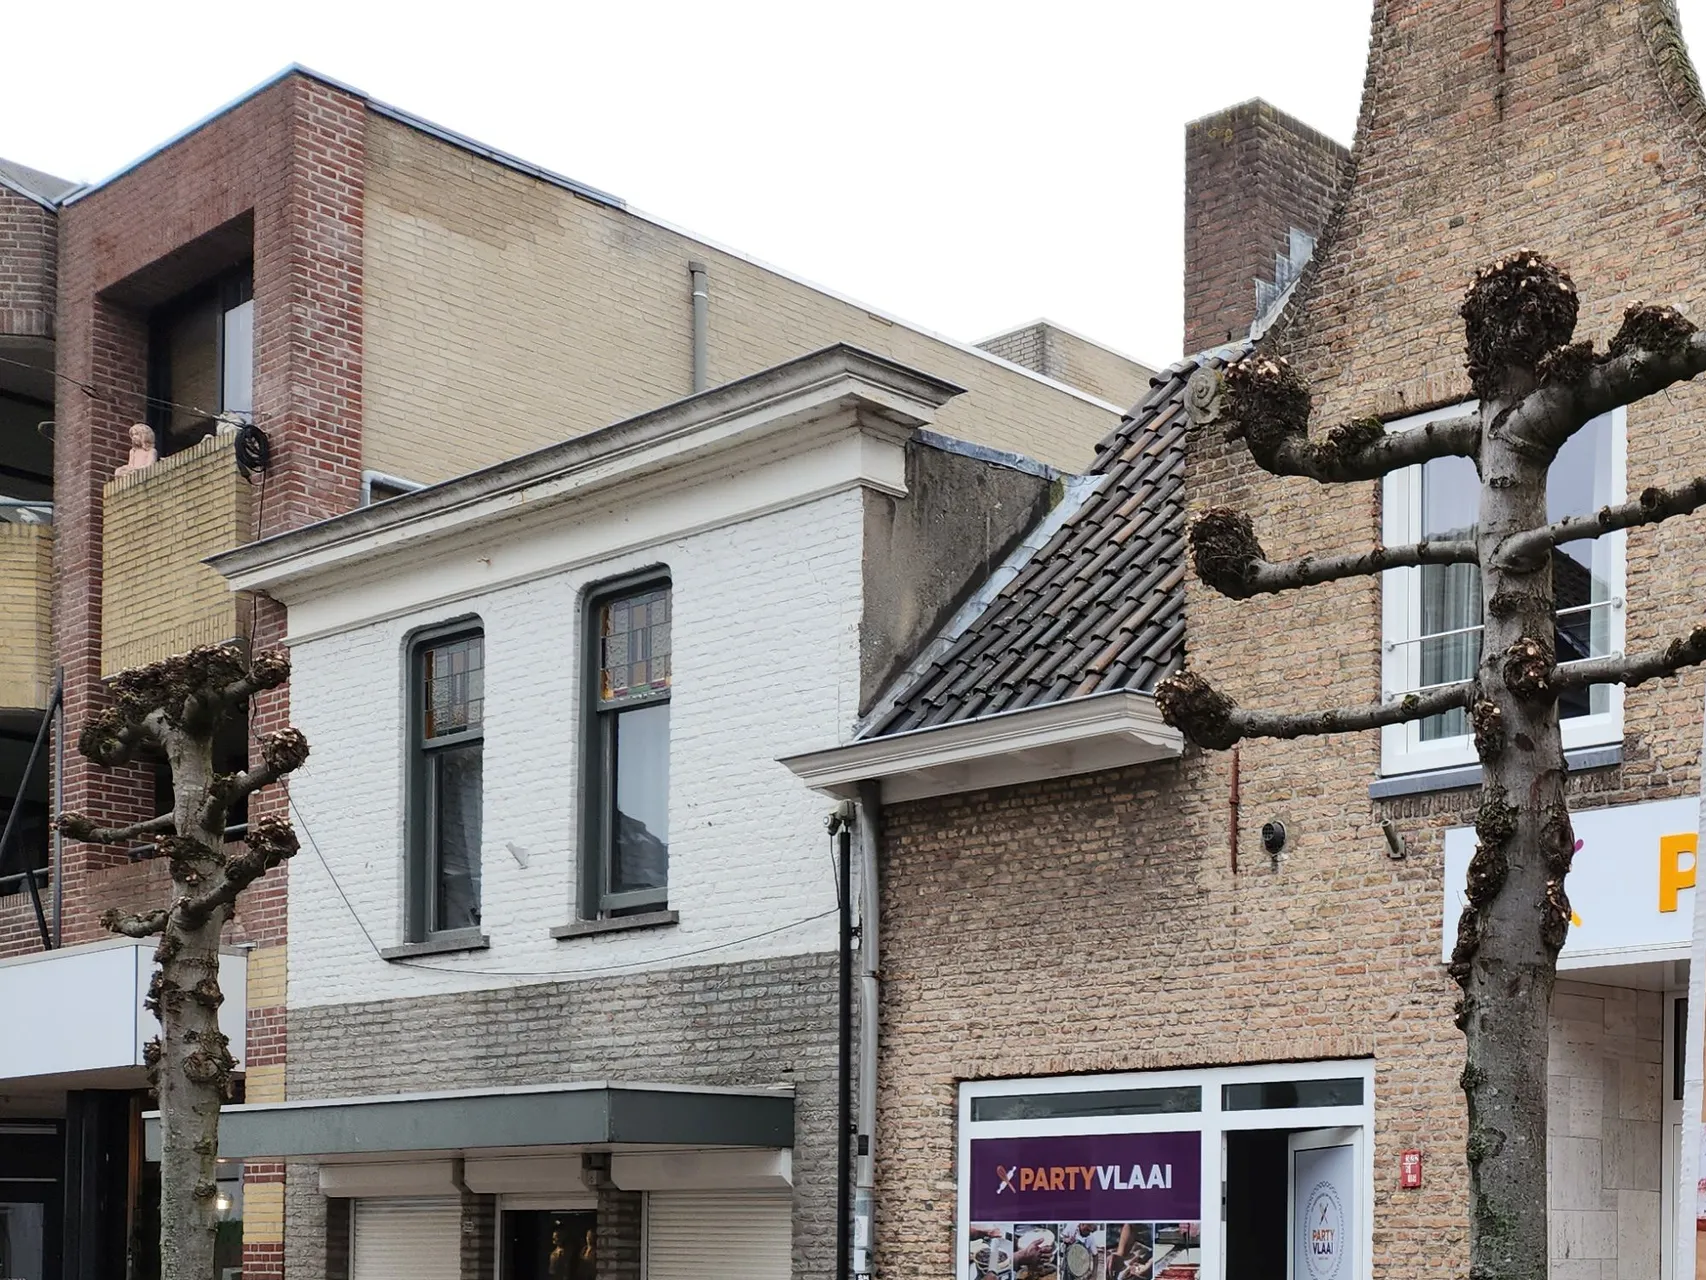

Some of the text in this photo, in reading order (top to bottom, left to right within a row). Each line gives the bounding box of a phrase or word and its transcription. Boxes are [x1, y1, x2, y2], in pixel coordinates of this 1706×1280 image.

[1020, 1164, 1172, 1191] PARTYVLAAI
[1312, 1229, 1335, 1242] PARTY
[1312, 1242, 1334, 1255] VLAAI
